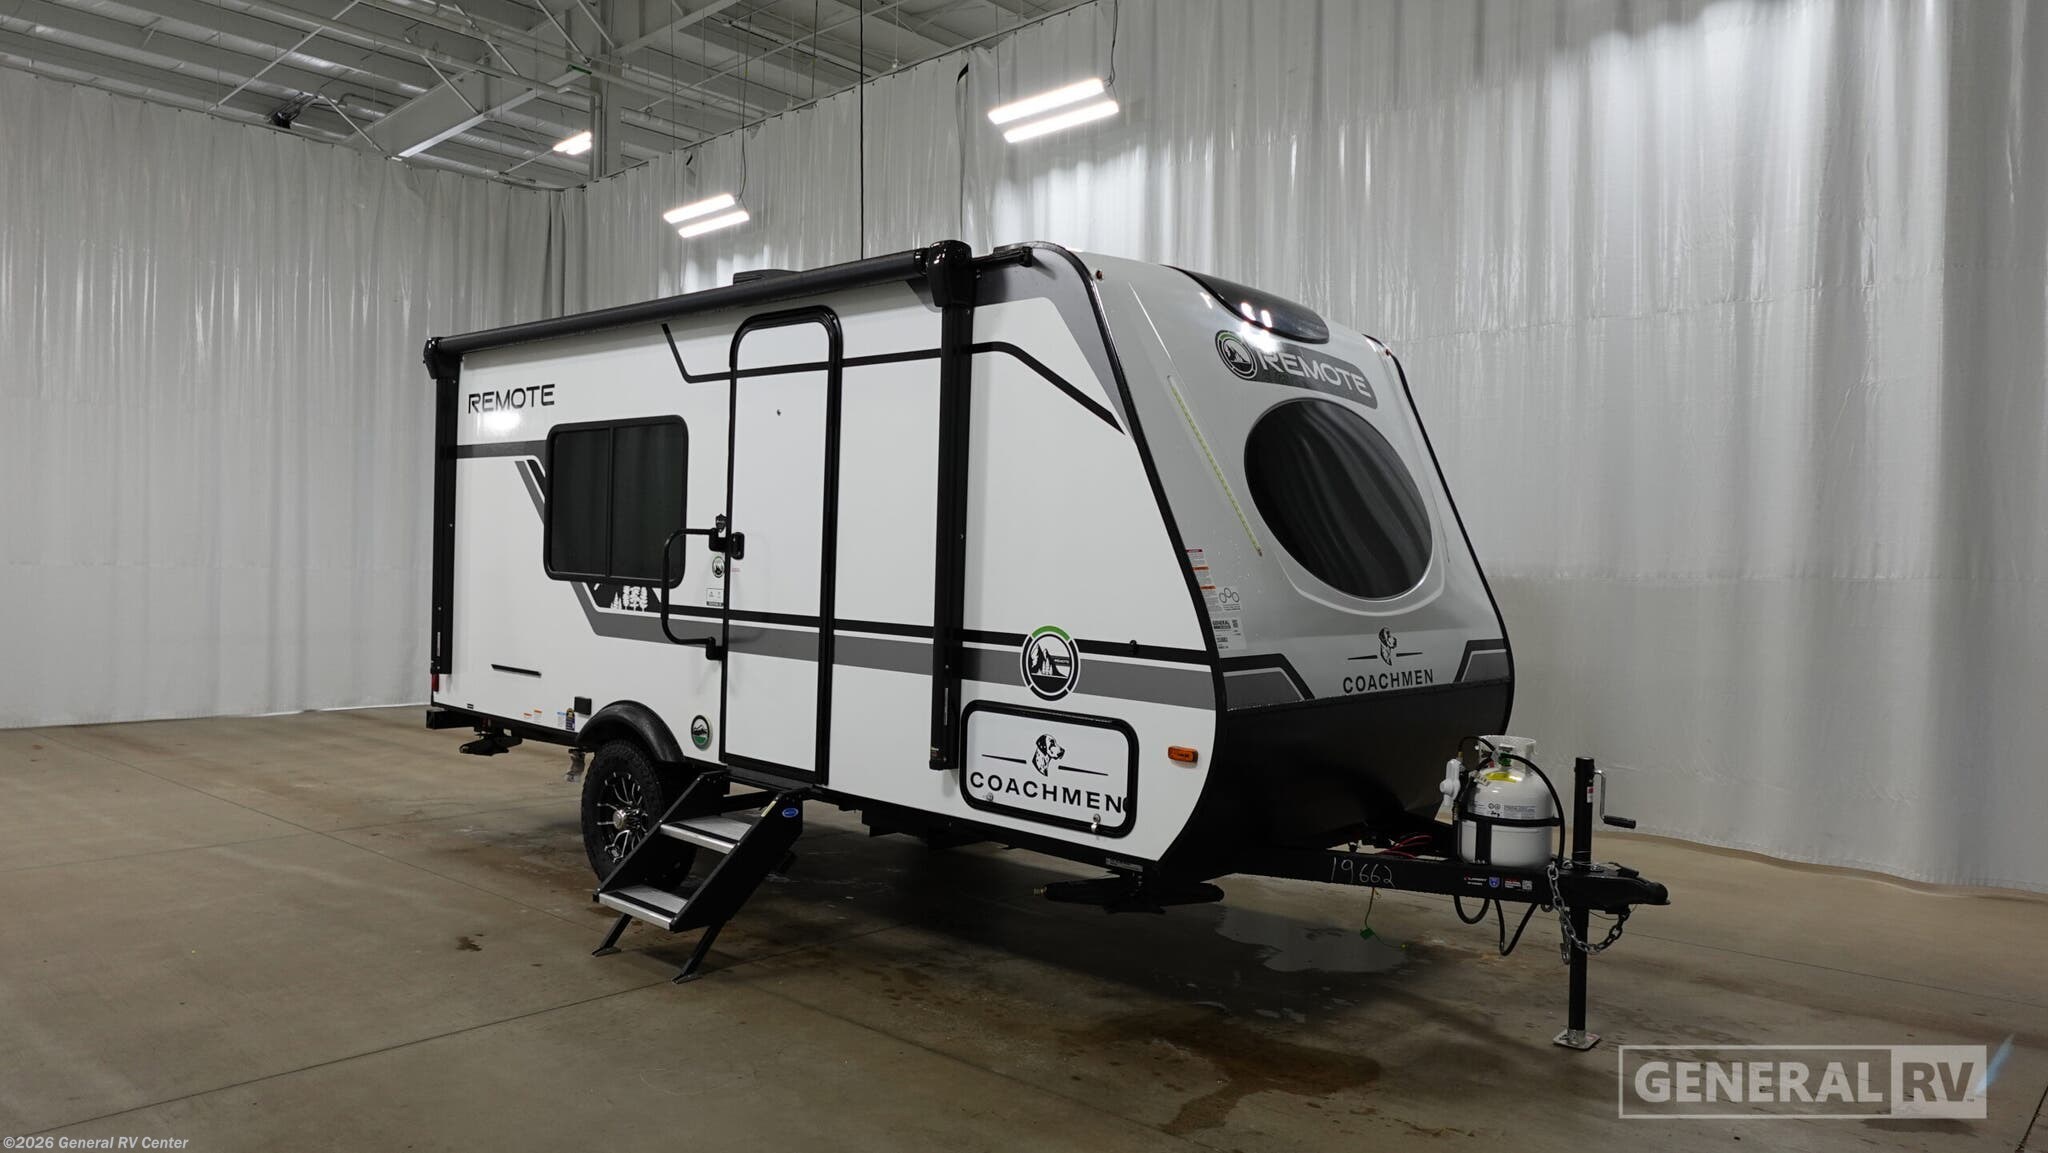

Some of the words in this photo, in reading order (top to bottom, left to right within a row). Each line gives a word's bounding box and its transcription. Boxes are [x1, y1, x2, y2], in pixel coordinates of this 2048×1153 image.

[1259, 351, 1372, 398] REMOTE
[468, 383, 555, 414] REMOTE
[1342, 668, 1434, 694] COACHMEN
[970, 771, 1122, 814] COACHMEN
[1330, 856, 1396, 888] 19662
